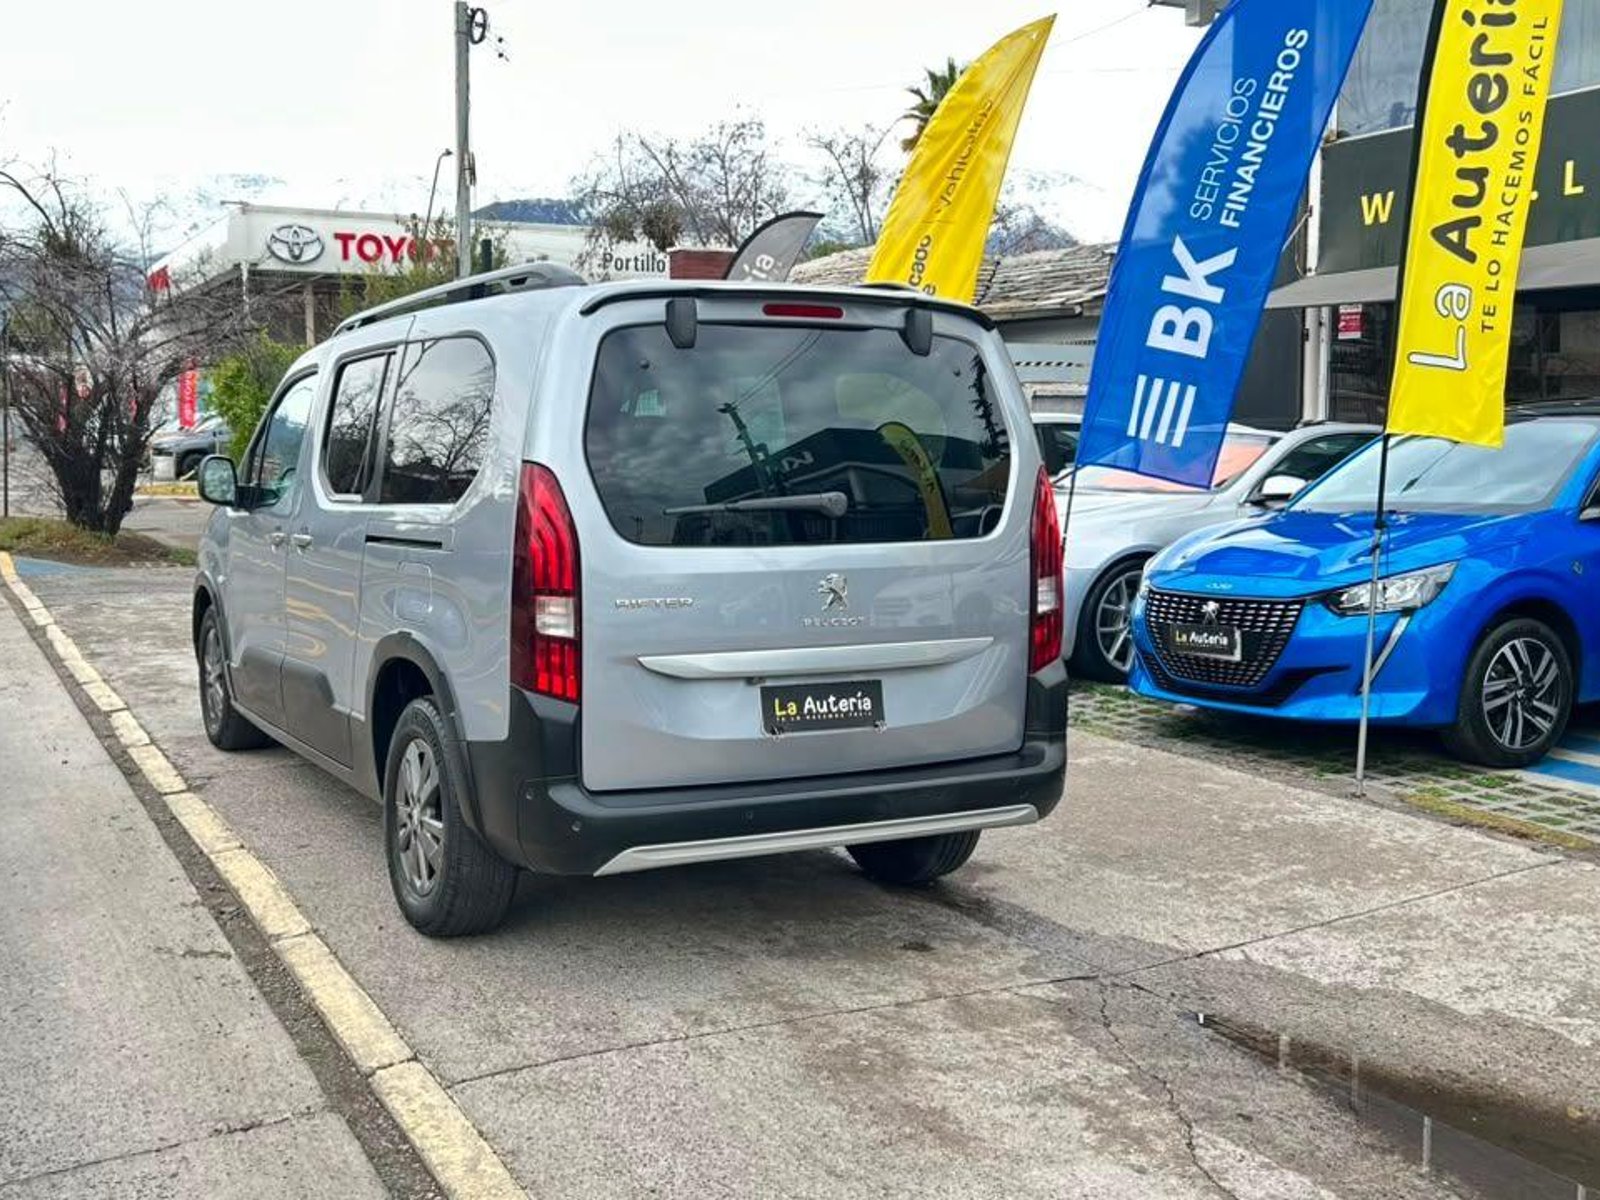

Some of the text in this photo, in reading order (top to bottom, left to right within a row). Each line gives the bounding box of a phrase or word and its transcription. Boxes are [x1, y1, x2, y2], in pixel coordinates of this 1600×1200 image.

[1190, 77, 1257, 221] SERVICIOS
[1219, 28, 1309, 228] FINANCIEROS
[1407, 0, 1518, 371] La Auterí
[1481, 16, 1548, 333] TE LO HACEMOS FÁCIL
[602, 251, 667, 273] Portillo
[1145, 233, 1238, 359] BK
[774, 697, 797, 716] La
[803, 690, 872, 714] Autería
